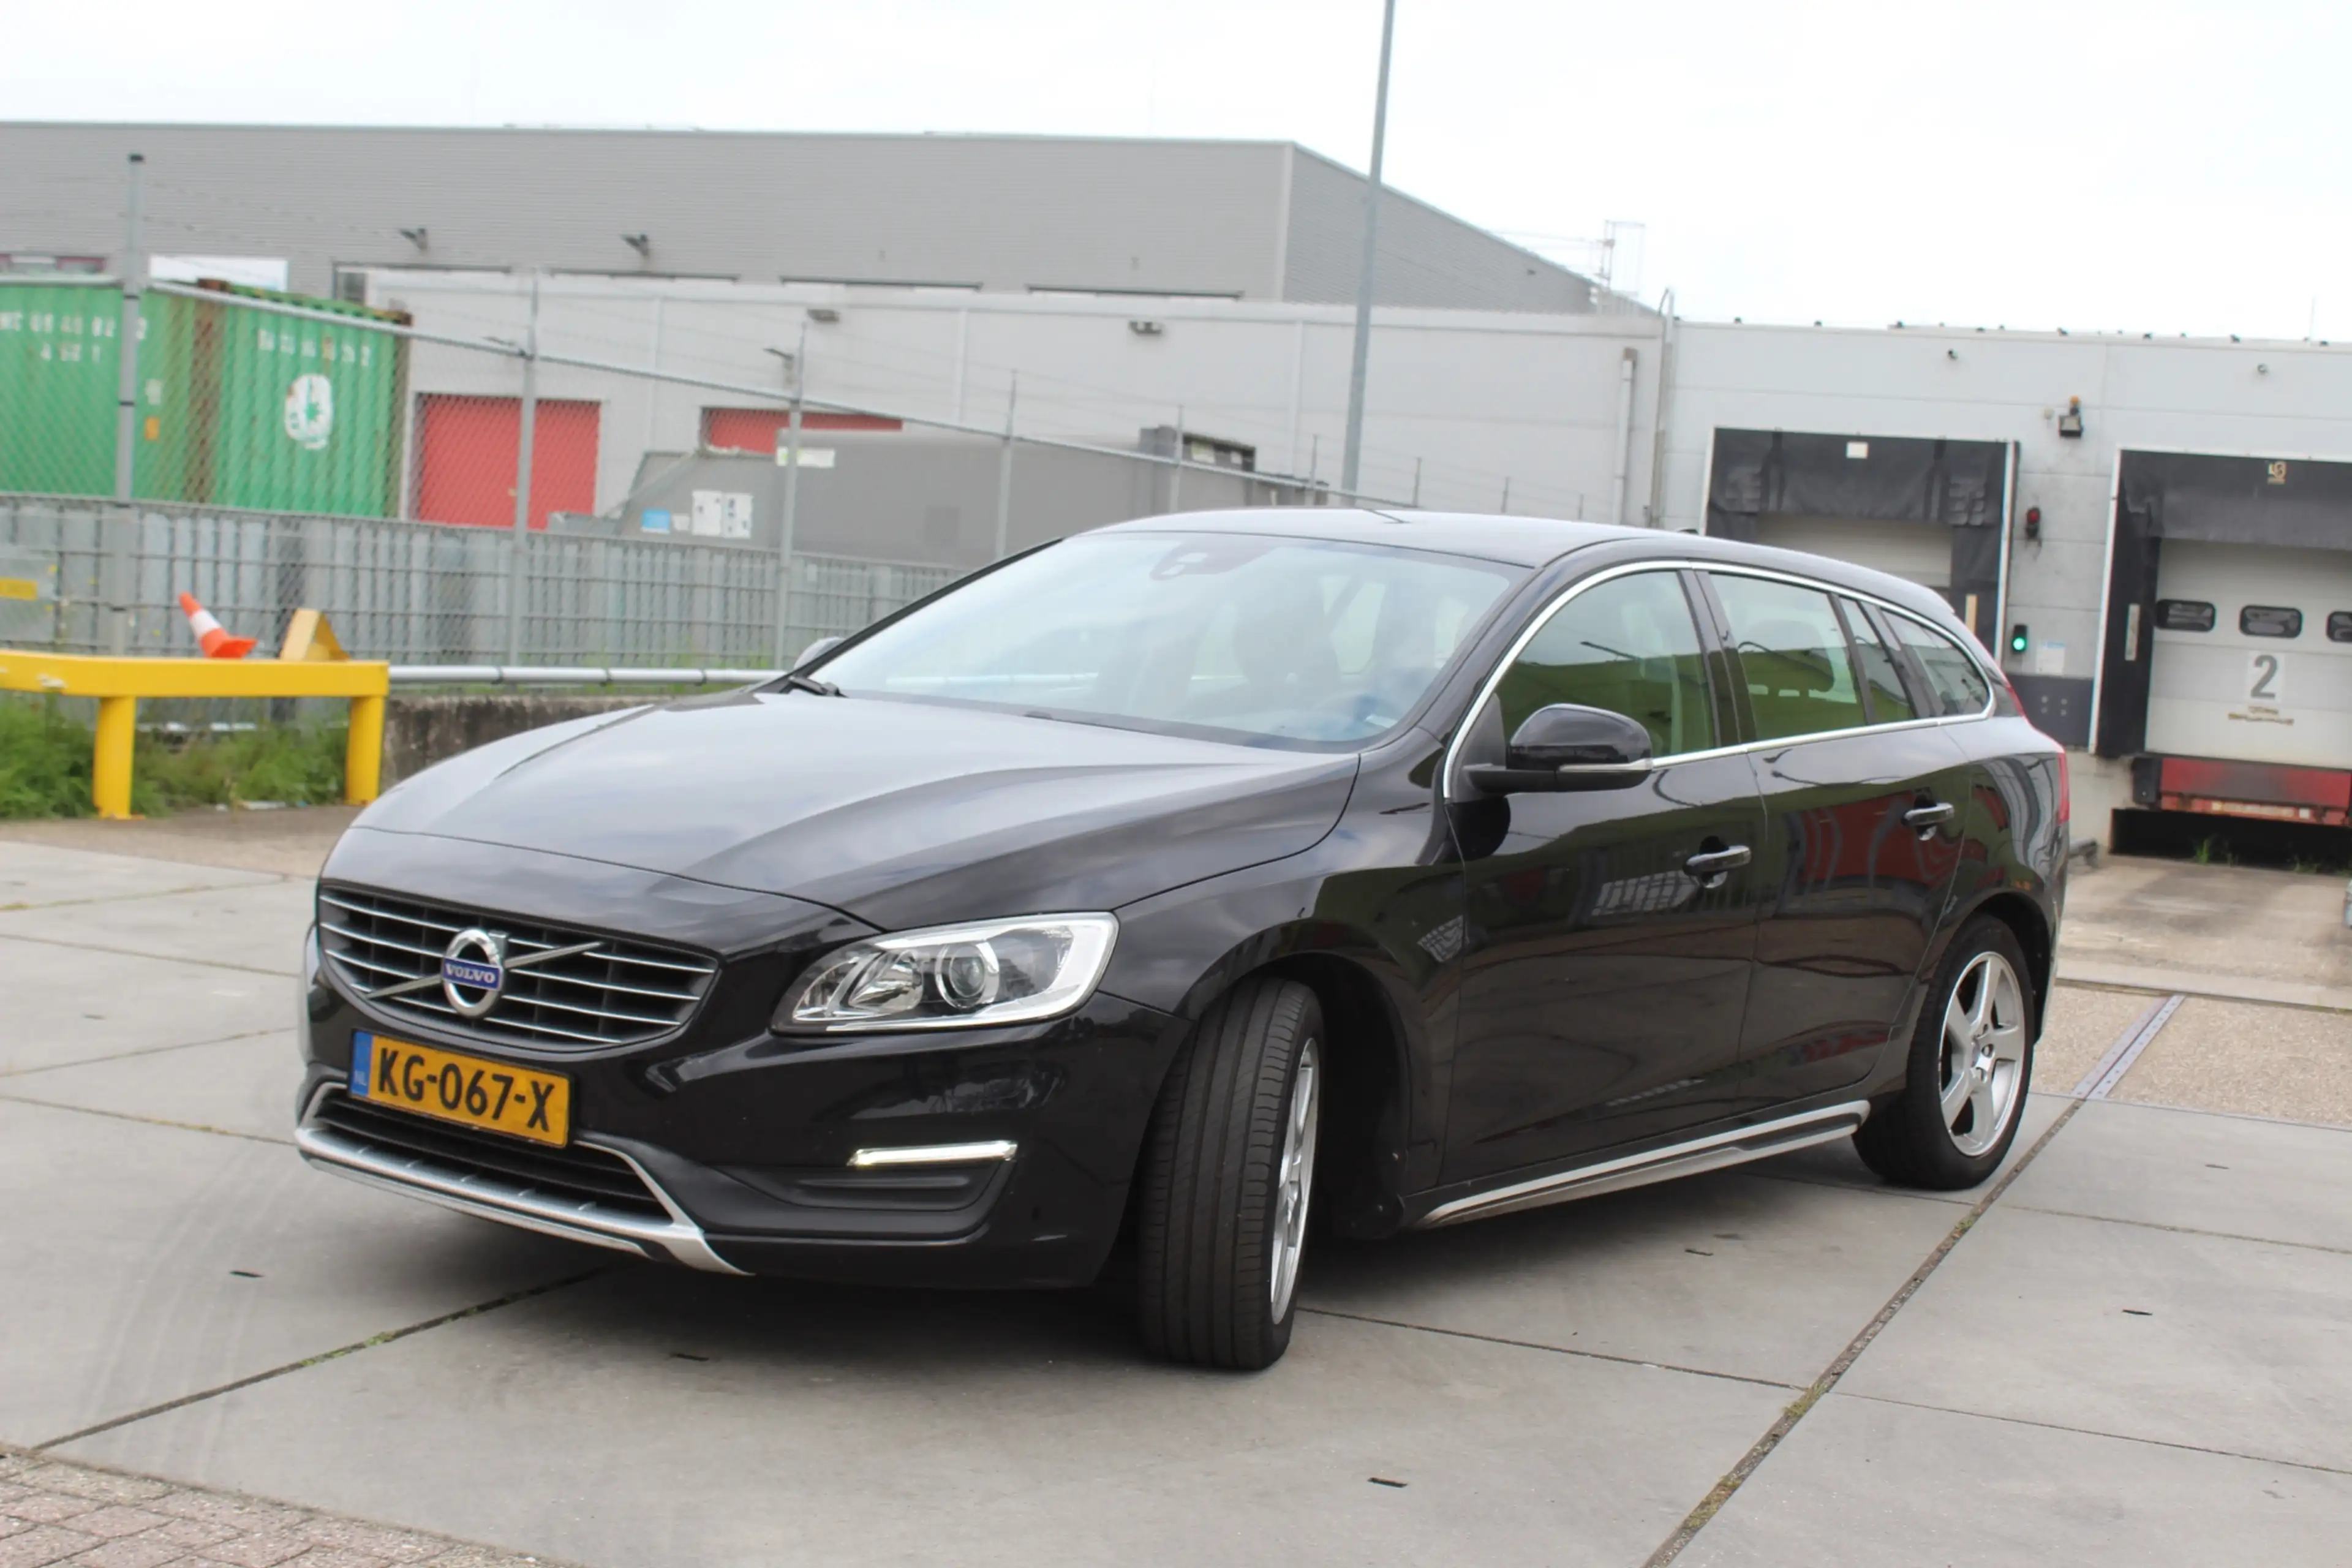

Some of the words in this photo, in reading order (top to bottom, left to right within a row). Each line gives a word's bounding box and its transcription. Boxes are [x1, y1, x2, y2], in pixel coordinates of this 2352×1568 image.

[2251, 654, 2278, 698] 2
[445, 963, 495, 984] VOLVO
[378, 1047, 555, 1133] KG-067-X
